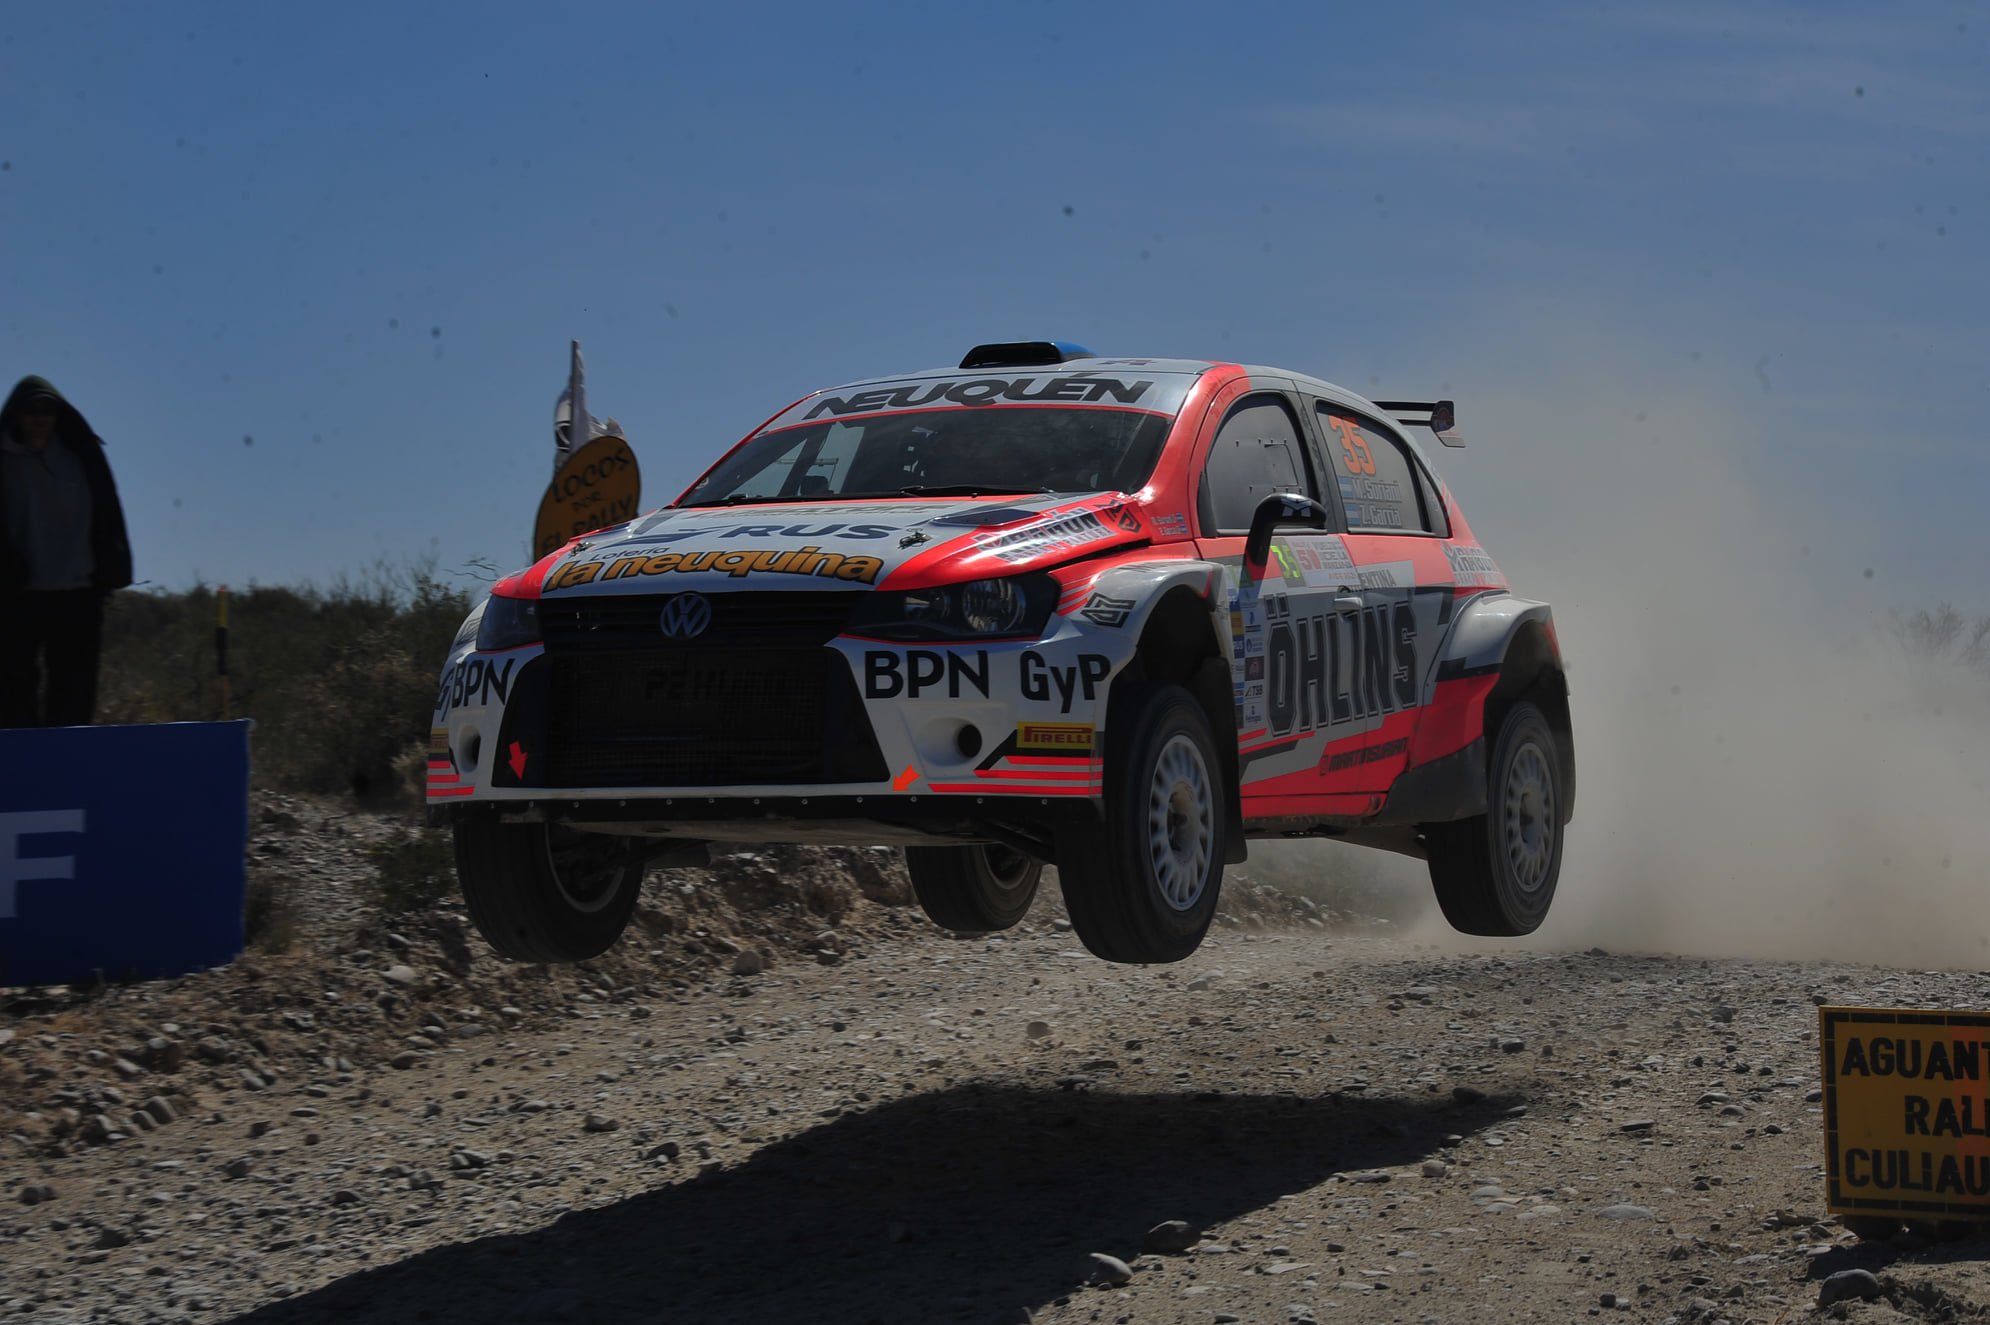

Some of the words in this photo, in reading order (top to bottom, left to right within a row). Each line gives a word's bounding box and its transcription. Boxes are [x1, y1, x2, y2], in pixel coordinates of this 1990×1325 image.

[802, 372, 1153, 416] NEUQUÉN
[1329, 415, 1376, 475] 35
[553, 447, 629, 502] LOCOS
[718, 524, 901, 539] RUS
[542, 560, 601, 593] la
[603, 546, 884, 586] neuquina
[452, 658, 514, 708] BPN
[865, 650, 989, 699] BPN
[1020, 650, 1112, 713] GyP
[1264, 591, 1418, 738] ÖHLINS
[1024, 725, 1093, 744] PIRELLI
[1904, 1095, 1990, 1138] RAL
